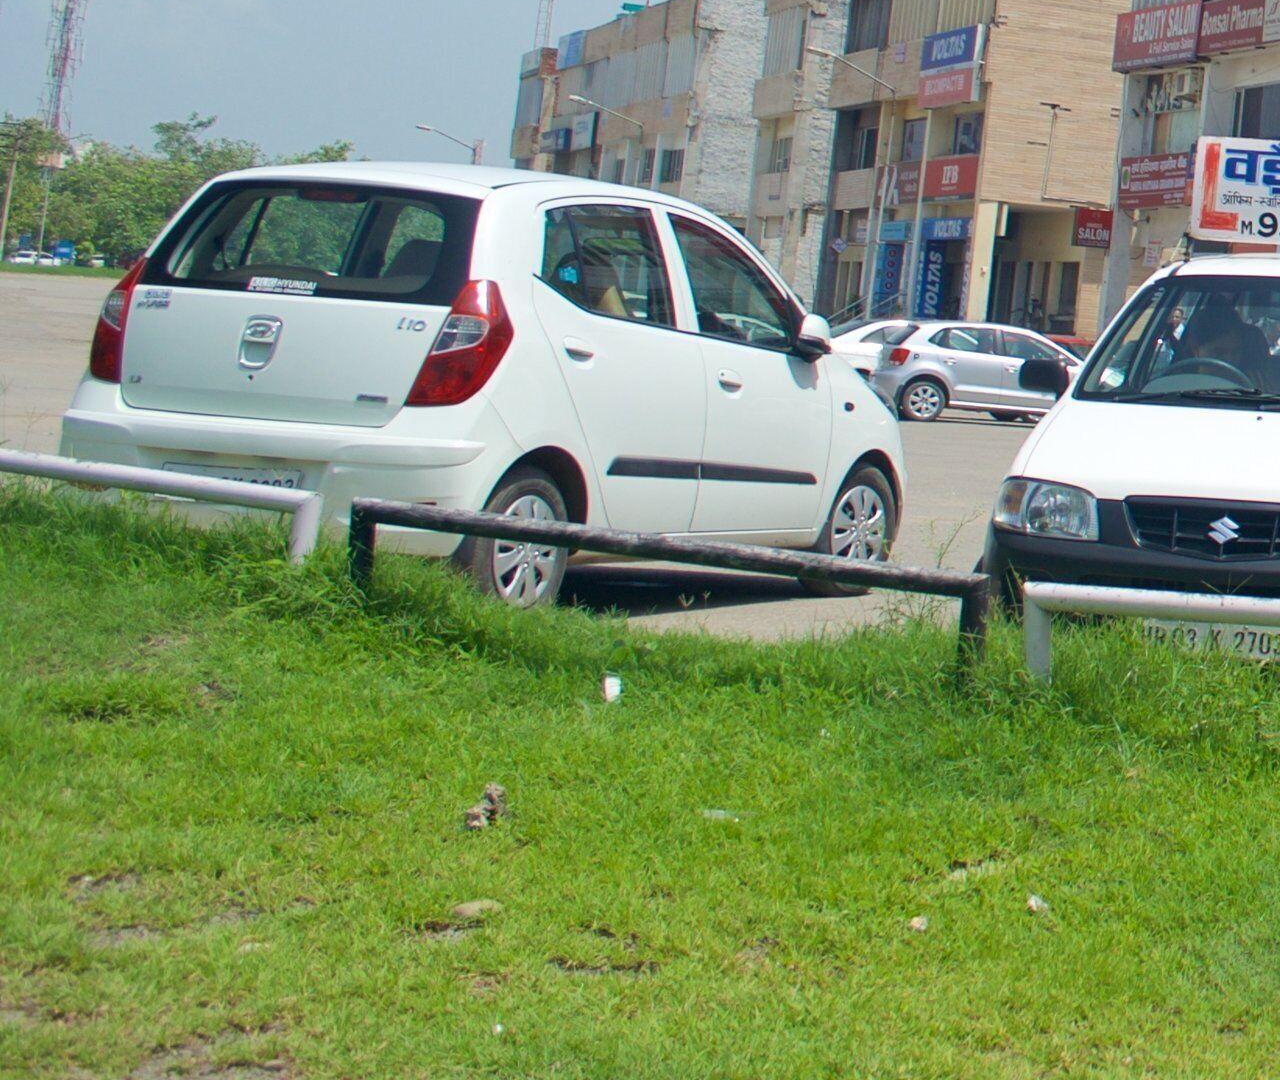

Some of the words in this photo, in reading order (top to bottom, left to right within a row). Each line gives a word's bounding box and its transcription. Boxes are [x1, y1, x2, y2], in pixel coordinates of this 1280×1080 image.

[1132, 9, 1168, 43] BEAUTY
[1167, 3, 1200, 38] SALON
[1201, 6, 1231, 36] Bonsai
[1230, 4, 1264, 33] Pharma
[931, 34, 966, 61] VOLTAS
[941, 165, 960, 184] IFB
[933, 219, 962, 238] VOLTAS
[1078, 227, 1110, 241] SALON
[277, 279, 318, 290] HYUNDAI
[924, 251, 943, 316] VOLTAS
